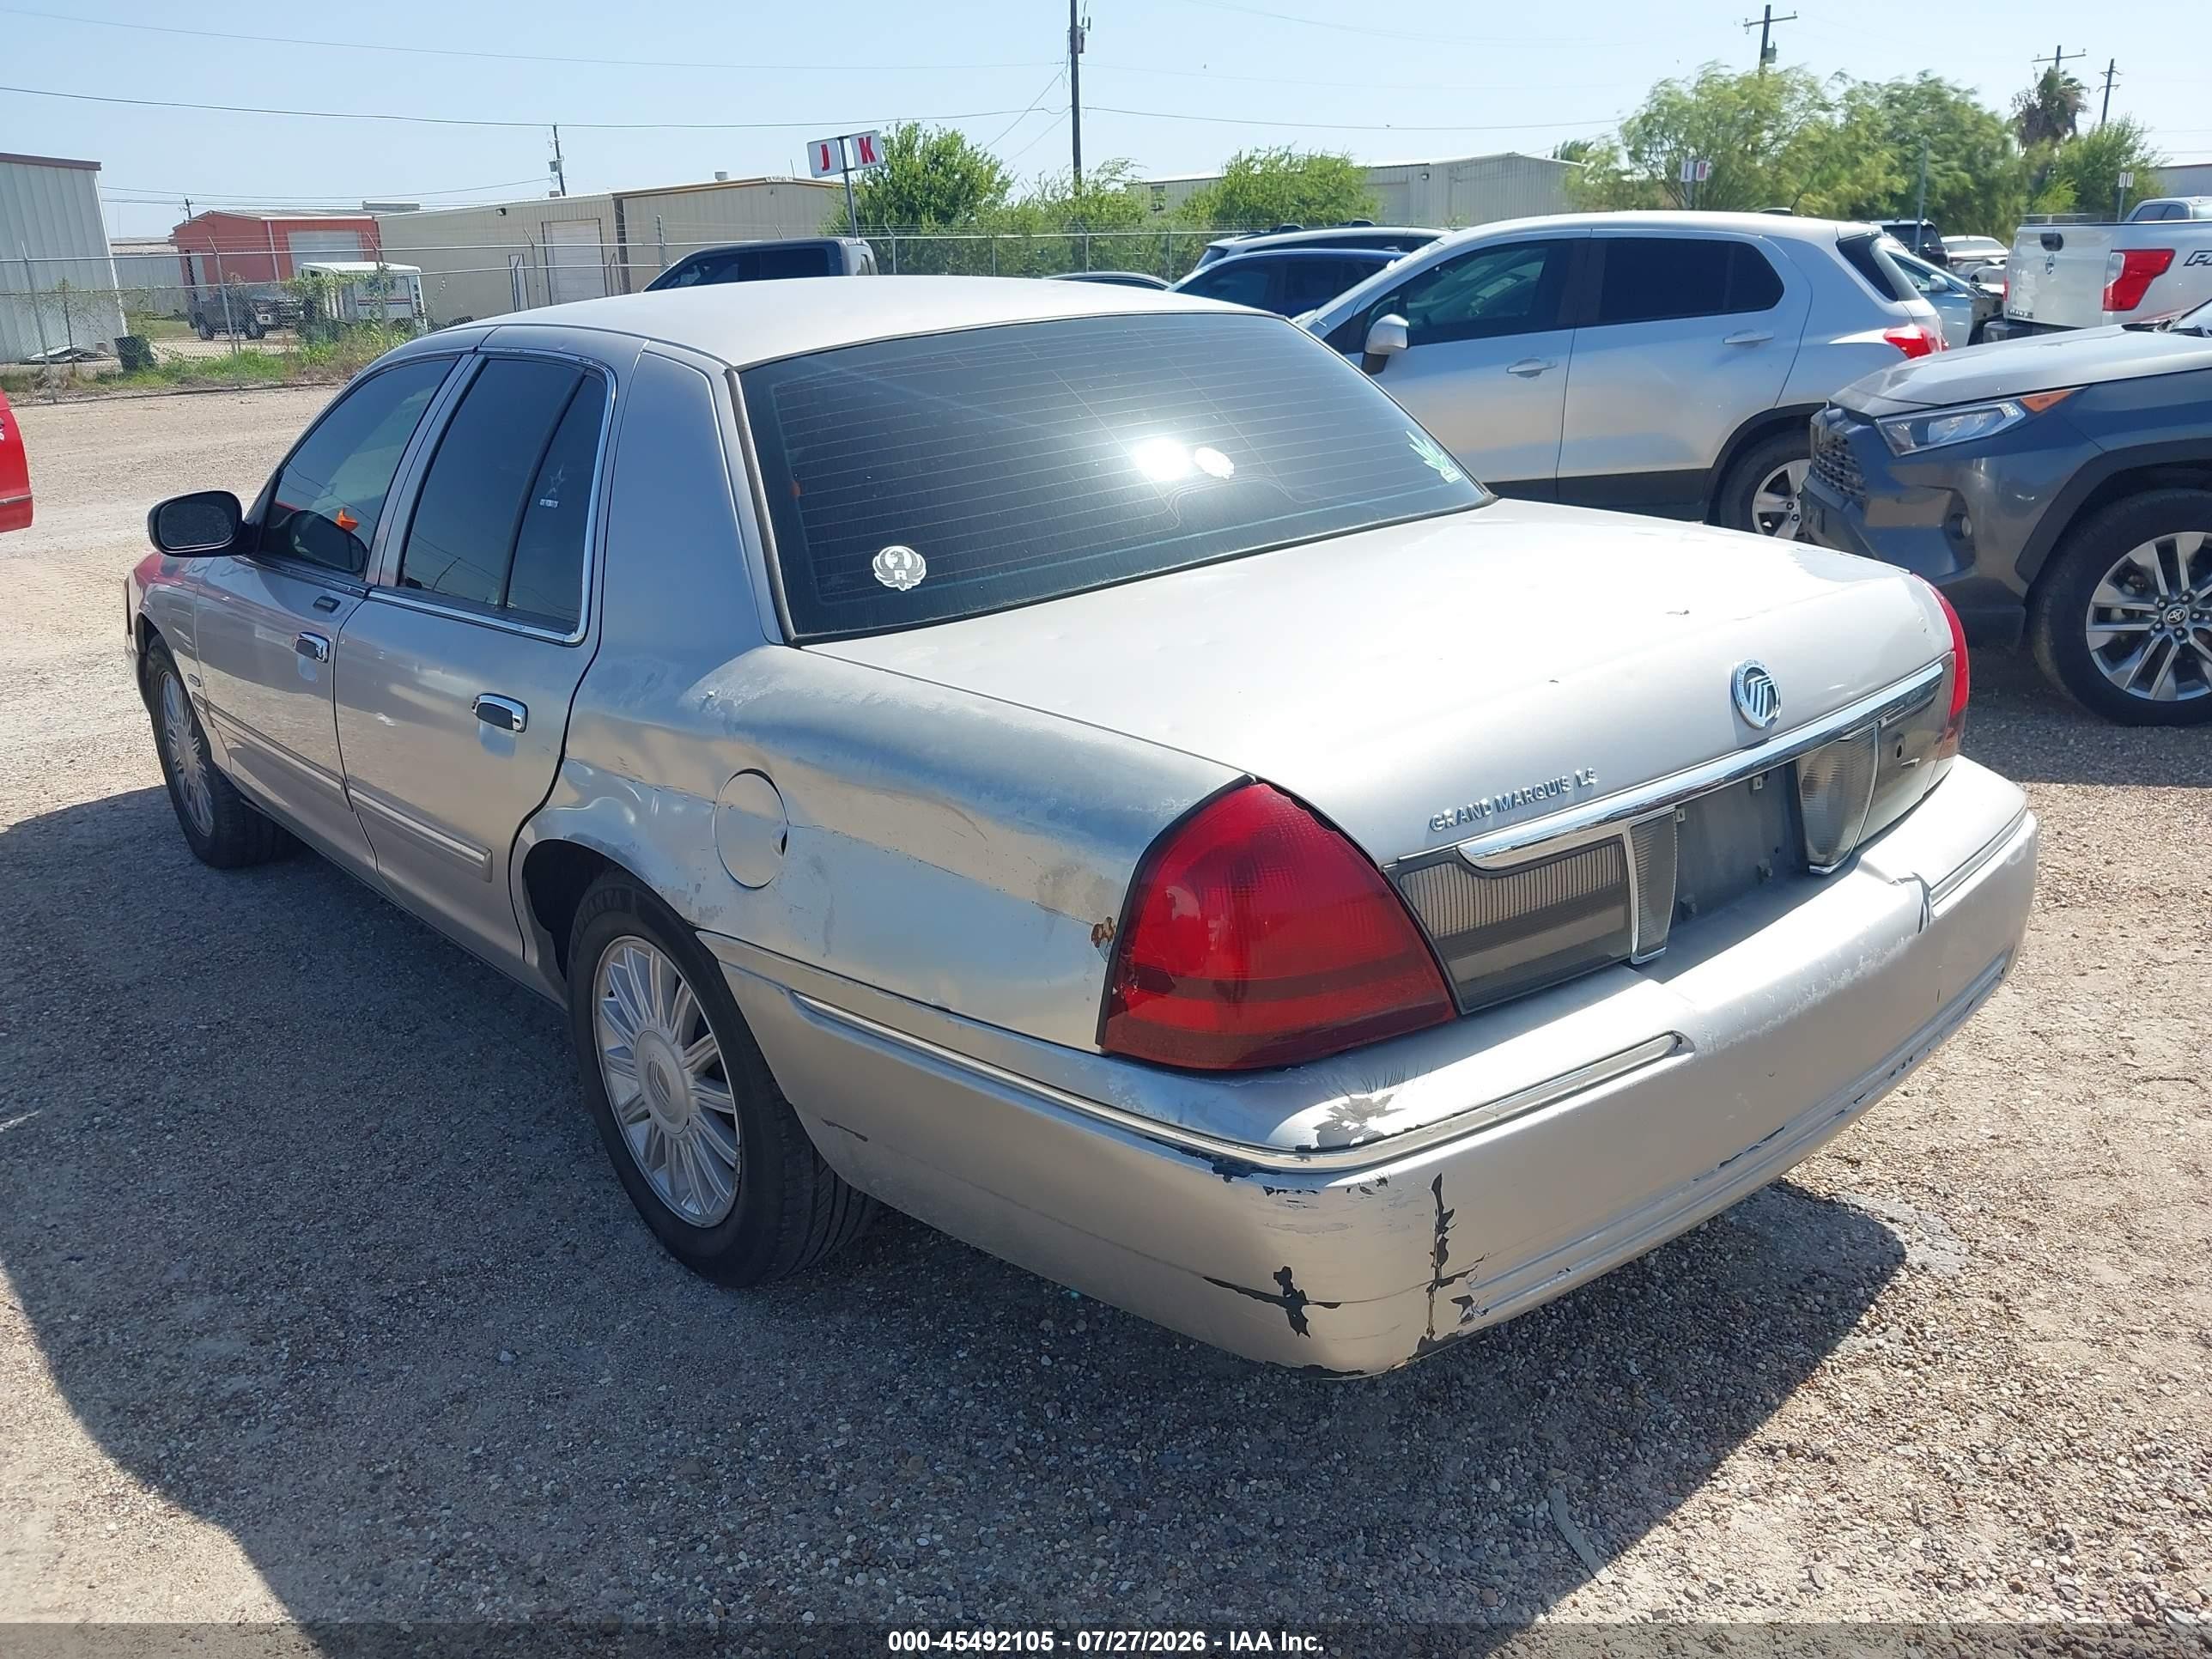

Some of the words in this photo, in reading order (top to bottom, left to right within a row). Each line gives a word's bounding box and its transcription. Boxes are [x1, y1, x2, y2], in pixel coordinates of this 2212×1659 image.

[821, 143, 830, 172] J
[858, 136, 877, 165] K
[894, 569, 908, 580] R
[1430, 797, 1492, 832] GRAND
[1493, 775, 1572, 813] MARQUIS
[1575, 767, 1600, 787] LS
